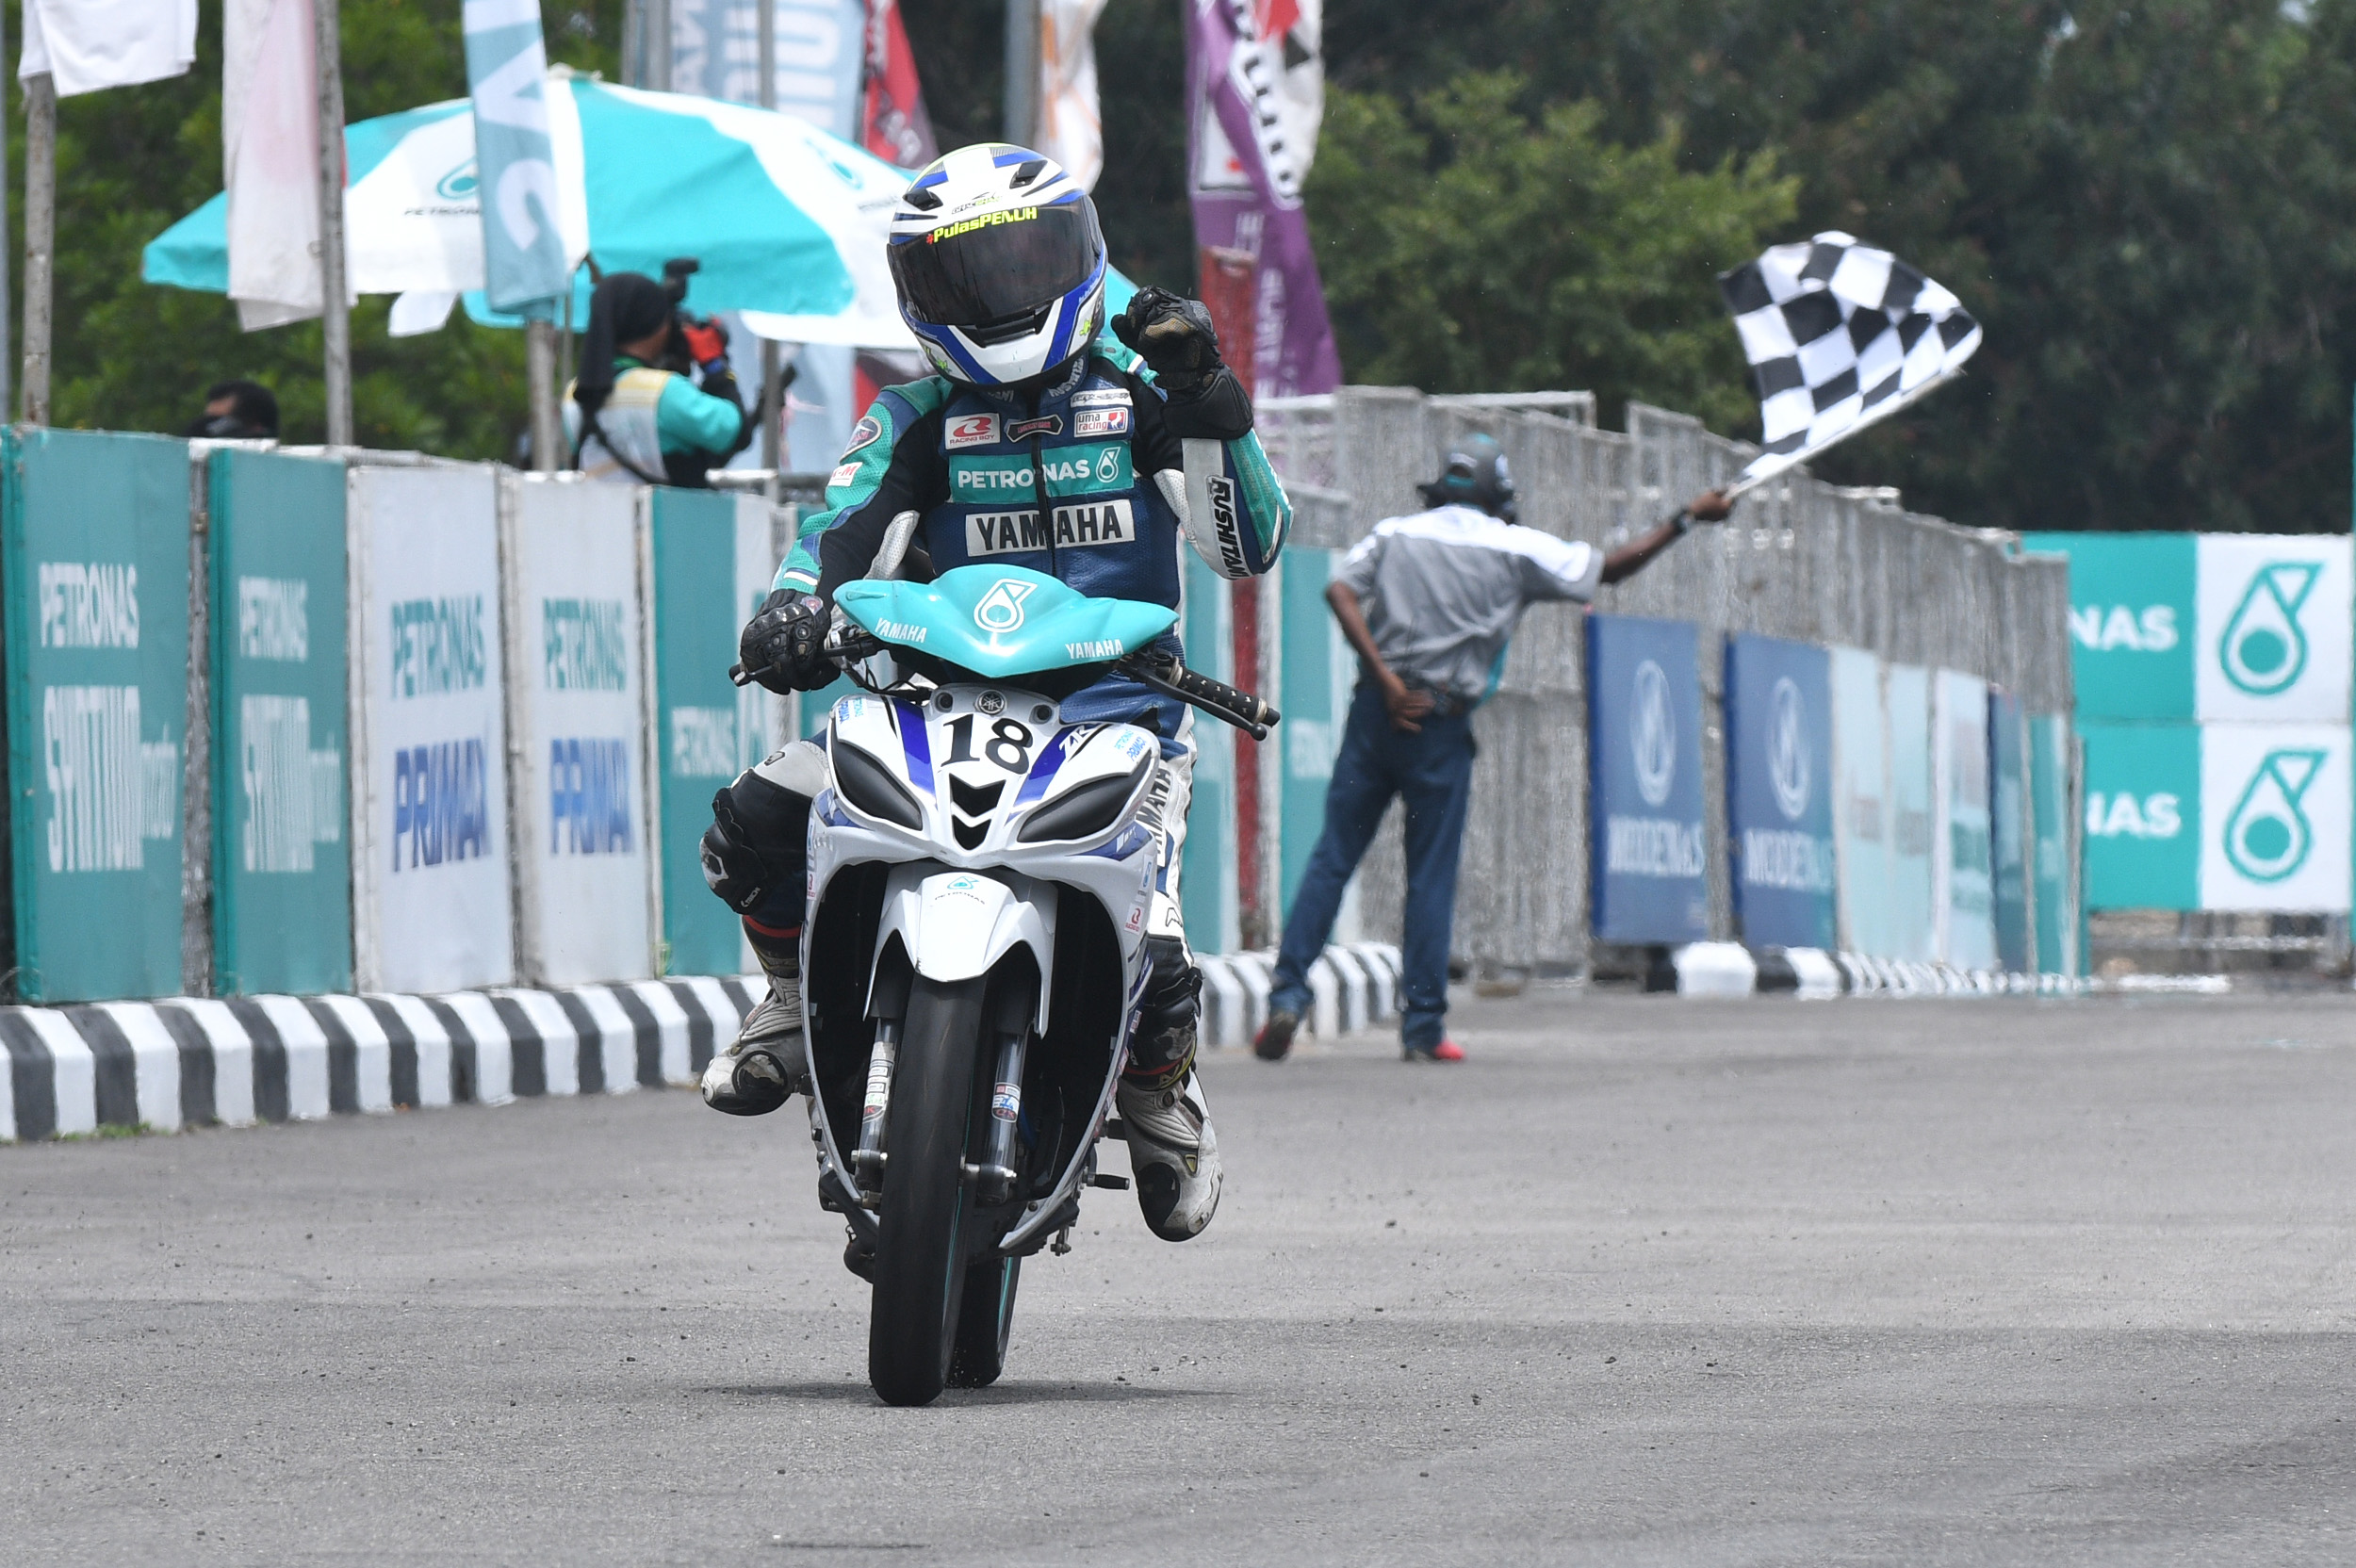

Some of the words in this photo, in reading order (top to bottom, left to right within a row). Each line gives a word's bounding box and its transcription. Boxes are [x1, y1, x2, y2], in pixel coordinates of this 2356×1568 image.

[926, 206, 1038, 245] #PulasPENUH
[1077, 413, 1102, 424] uma
[1077, 420, 1108, 432] racing
[949, 435, 979, 446] RACING
[979, 433, 996, 443] BOY
[957, 459, 1090, 488] PETRONAS
[975, 505, 1123, 551] YAMAHA
[875, 617, 927, 644] YAMAHA
[1065, 639, 1124, 660] YAMAHA
[941, 713, 1034, 775] 18
